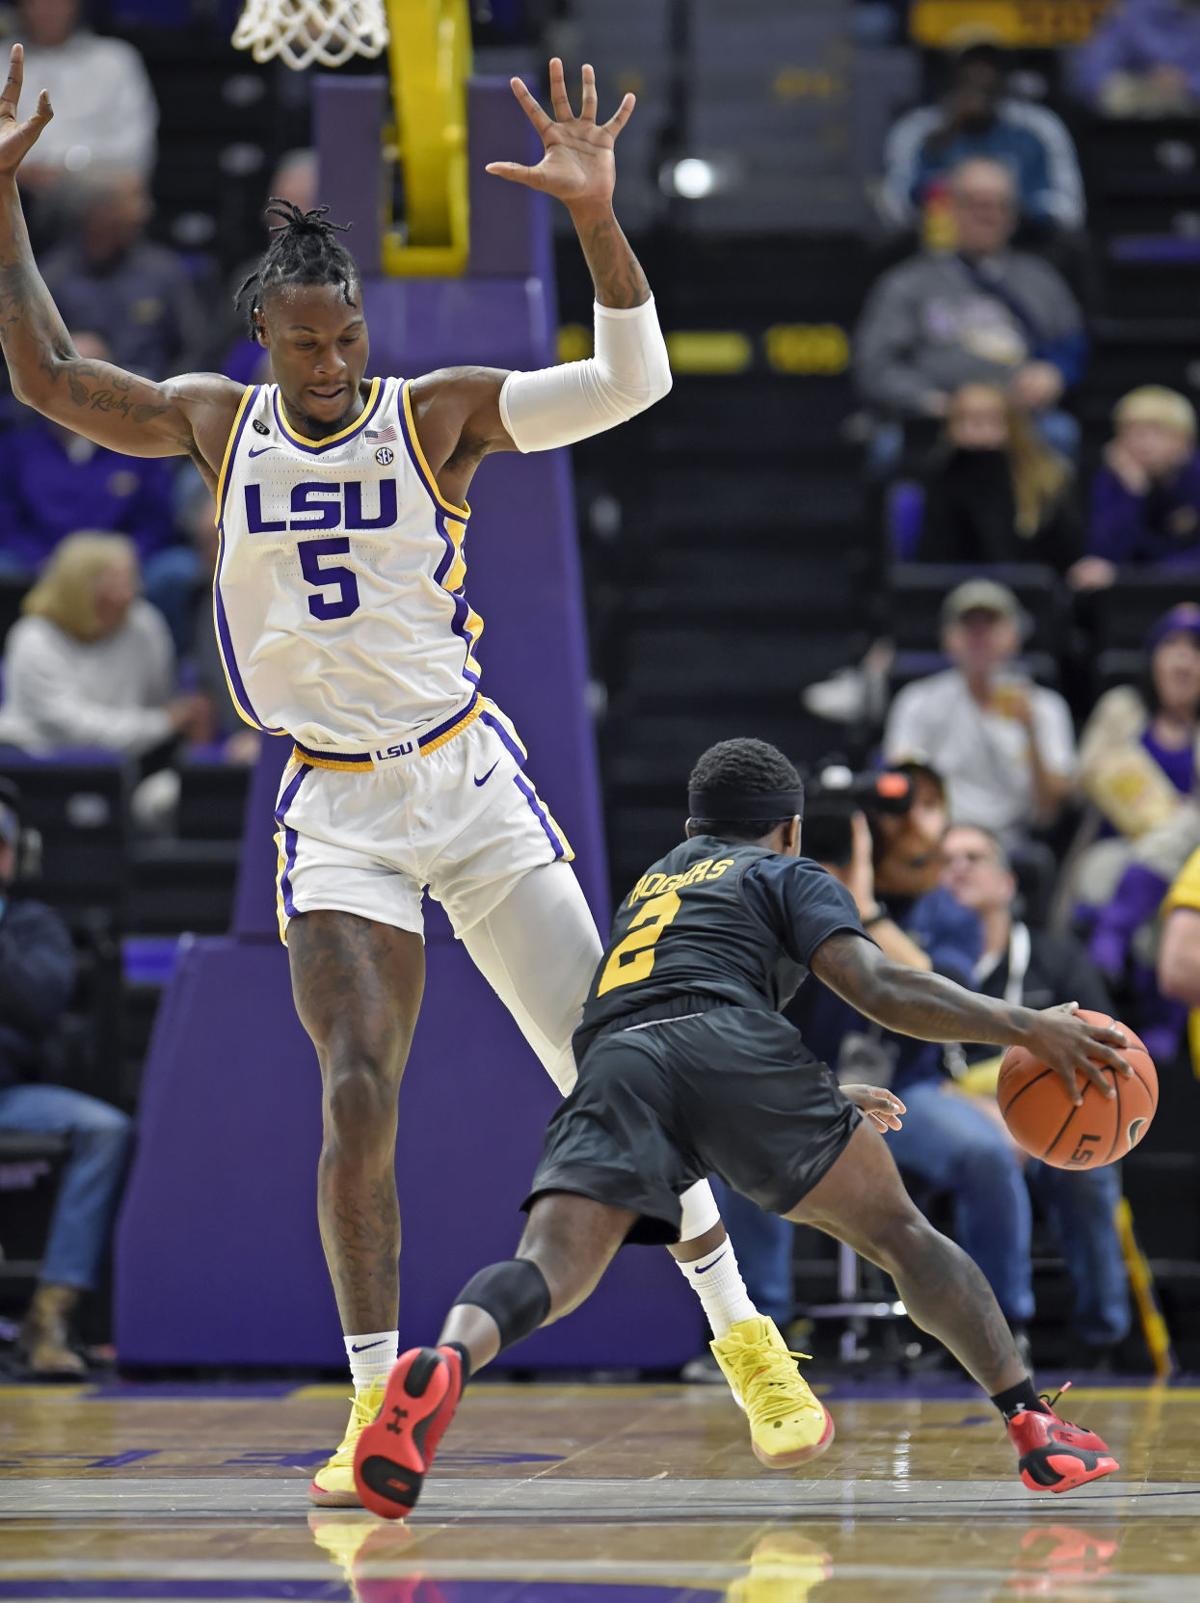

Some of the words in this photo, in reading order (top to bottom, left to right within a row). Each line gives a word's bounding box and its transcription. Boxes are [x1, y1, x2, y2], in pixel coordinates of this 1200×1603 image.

[376, 447, 394, 465] SEC
[244, 478, 398, 534] LSU
[297, 536, 361, 621] 5
[376, 741, 413, 761] LSU
[597, 889, 682, 998] 2
